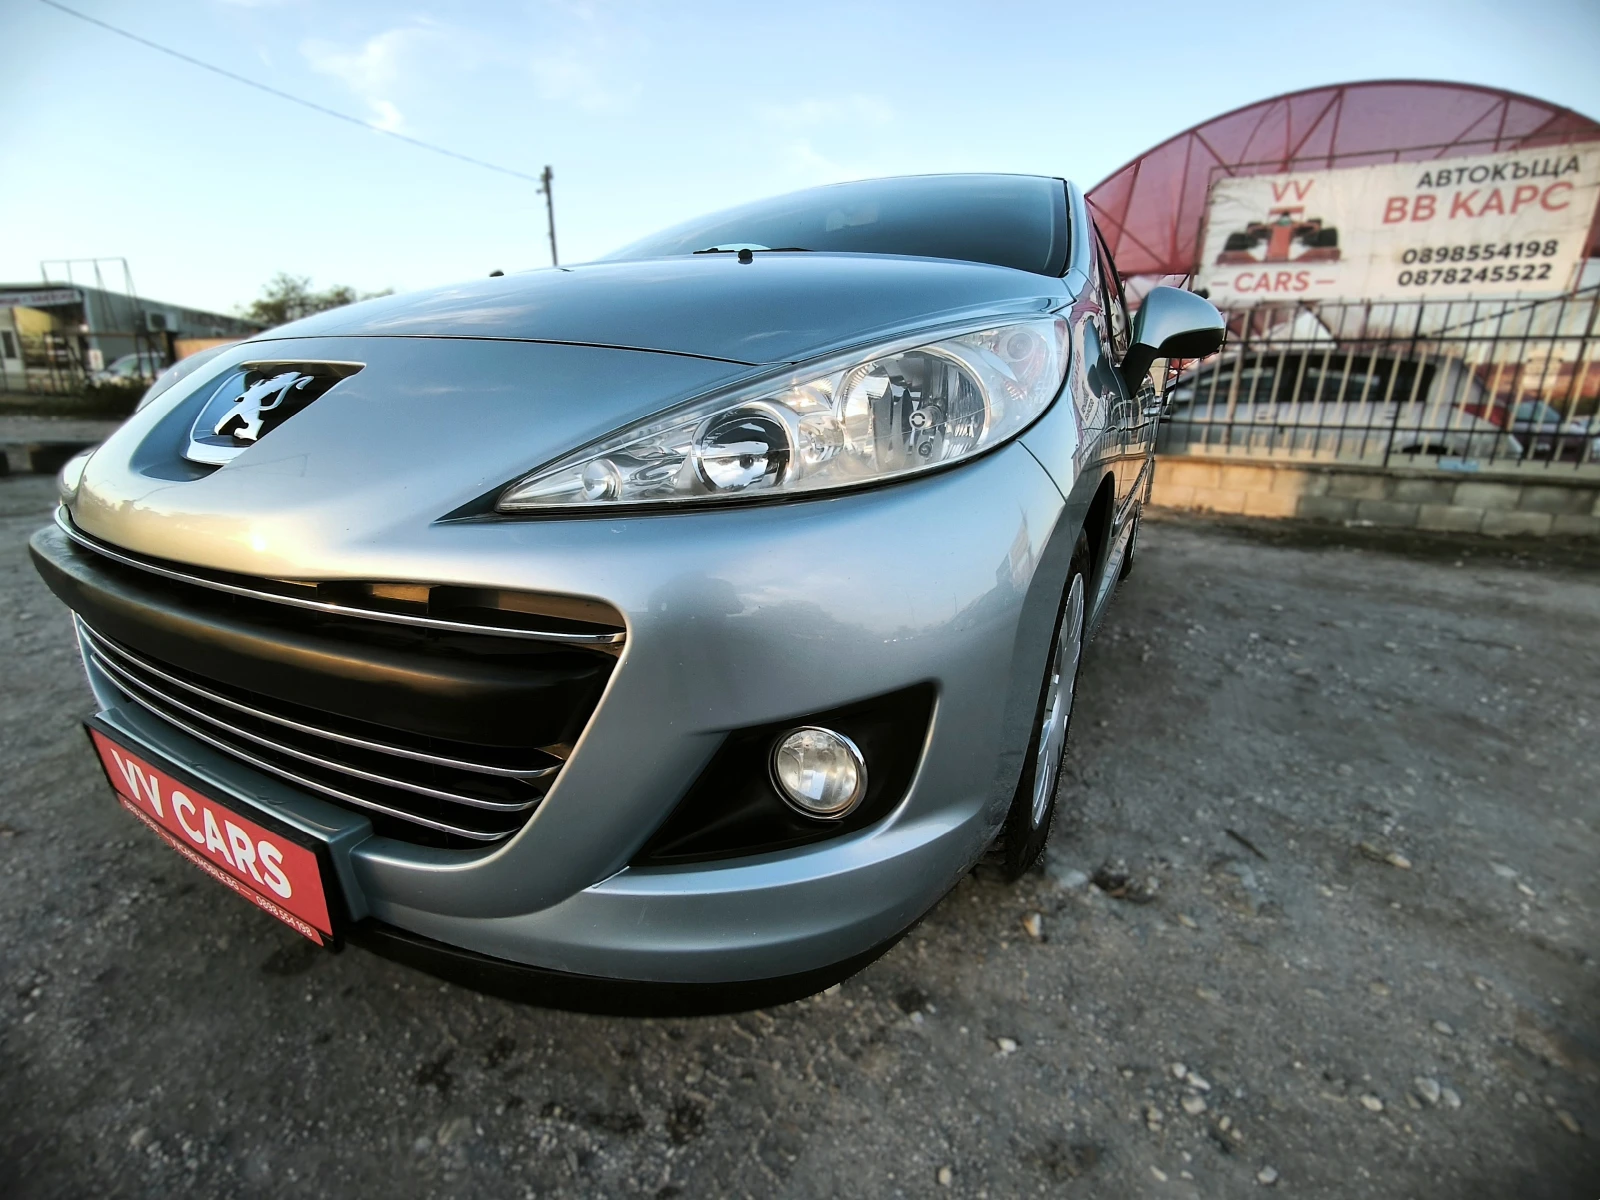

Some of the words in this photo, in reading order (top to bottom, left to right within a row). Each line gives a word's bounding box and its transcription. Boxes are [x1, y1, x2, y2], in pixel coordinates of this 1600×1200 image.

[1417, 155, 1581, 188] АВТОКЪЩА
[1271, 179, 1314, 202] VV
[1382, 193, 1438, 225] ВВ
[1448, 181, 1575, 220] КАРС
[1402, 239, 1559, 265] 0898554198
[1233, 270, 1312, 293] CARS
[1398, 263, 1553, 287] 0878245522
[110, 748, 165, 819] VV
[171, 790, 292, 899] CARS
